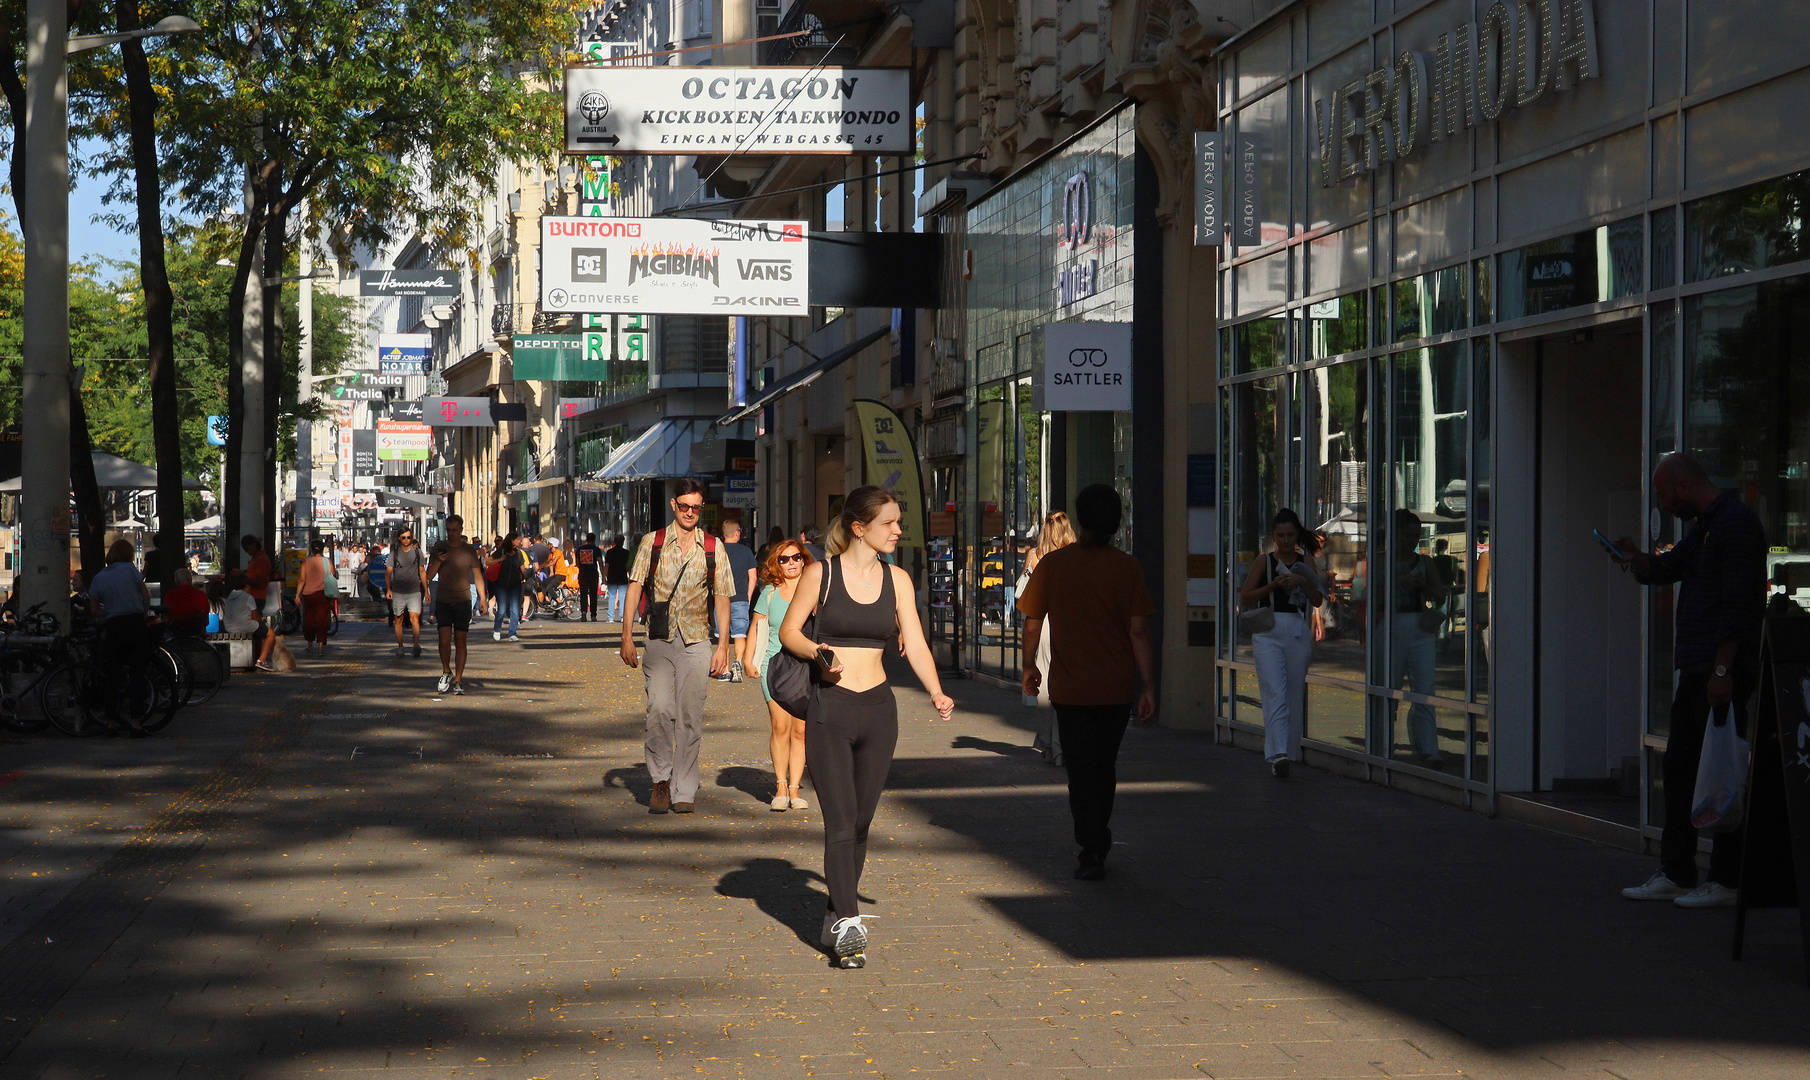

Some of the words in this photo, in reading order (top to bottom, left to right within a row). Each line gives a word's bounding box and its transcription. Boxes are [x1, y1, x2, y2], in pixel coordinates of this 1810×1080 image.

[681, 77, 858, 100] OCTAGON
[775, 110, 900, 124] TAEKWONDO
[1316, 50, 1428, 188] VERO
[660, 134, 745, 144] EINGANG
[757, 134, 855, 144] WEBGASSE
[864, 135, 884, 144] 45
[1204, 141, 1215, 185] VERO
[1204, 188, 1215, 238] MODA
[549, 221, 626, 237] BURTON
[737, 259, 792, 281] VANS
[366, 271, 453, 291] Hämmerle
[570, 294, 639, 304] CONVERSE
[711, 295, 802, 307] DAKINE
[514, 339, 559, 349] DEPOT
[361, 373, 403, 385] Thalia
[1053, 372, 1123, 386] SATTLER
[345, 388, 383, 399] Thalia
[379, 423, 430, 432] Kunstsupermarkt
[393, 438, 429, 448] teampool
